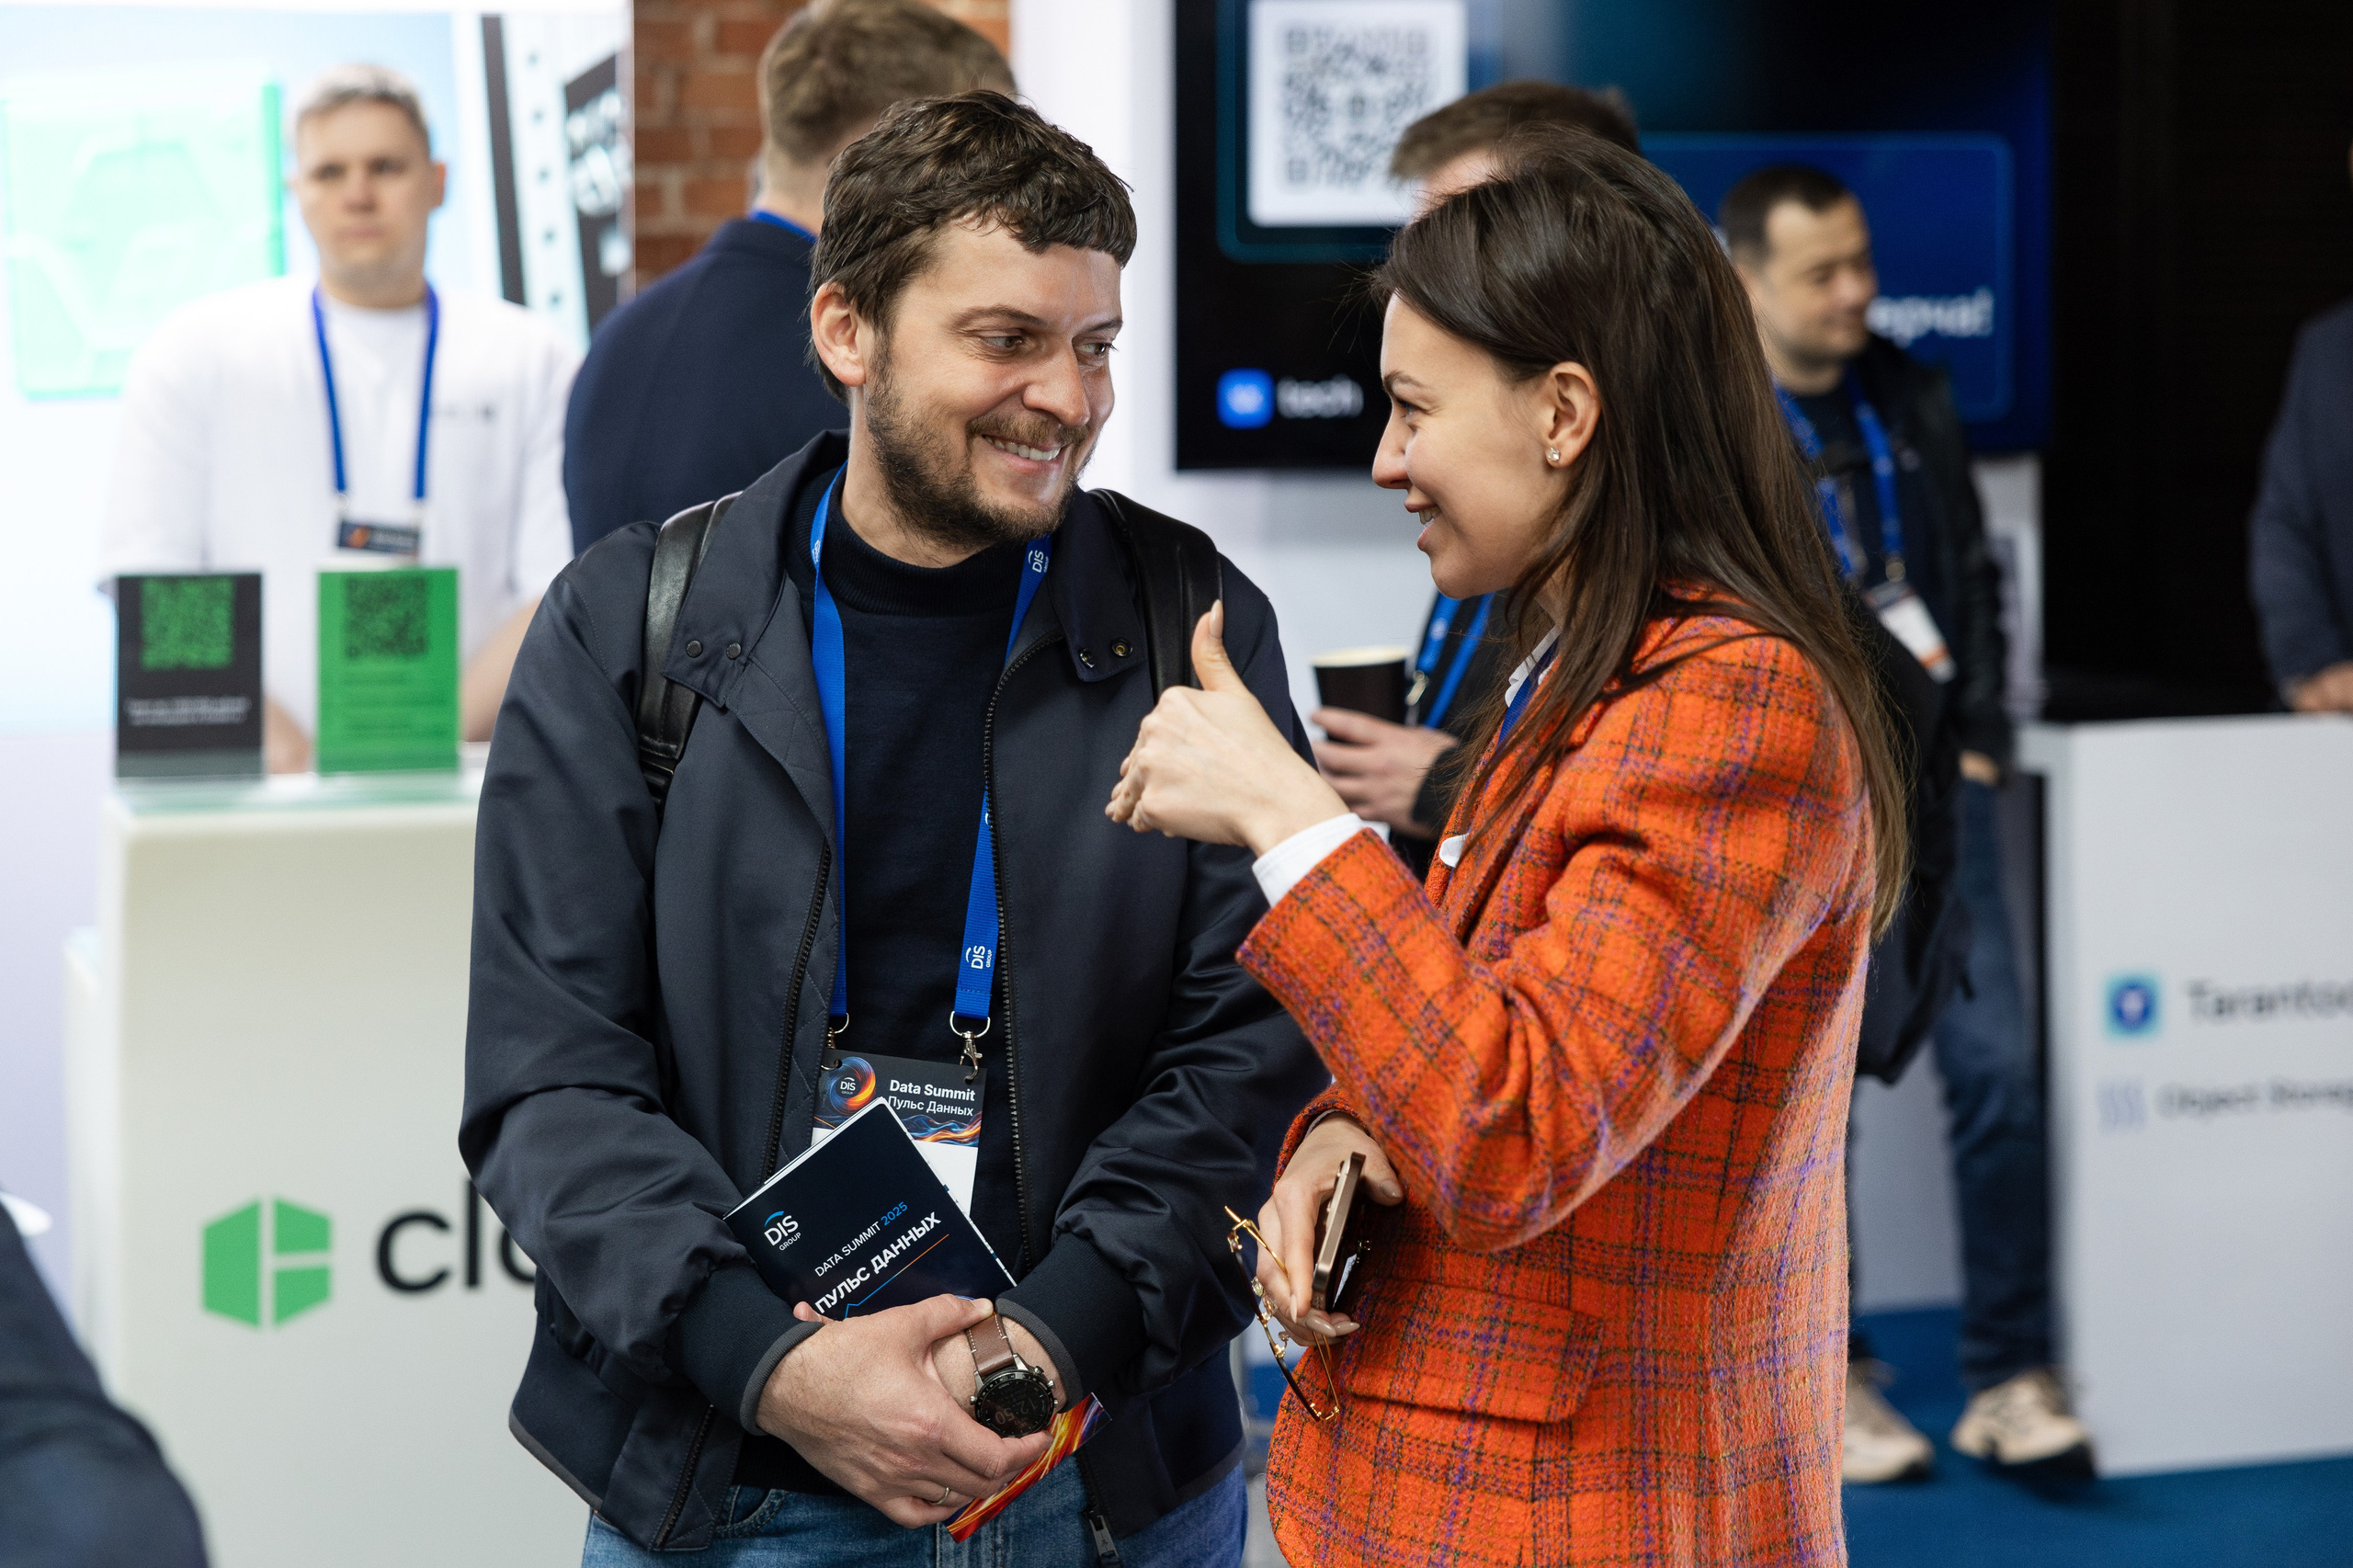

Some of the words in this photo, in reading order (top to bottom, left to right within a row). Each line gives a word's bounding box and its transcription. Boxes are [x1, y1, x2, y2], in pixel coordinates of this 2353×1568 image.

[1278, 375, 1362, 417] tech
[1032, 550, 1044, 574] DIS
[971, 945, 986, 970] DIS
[840, 1081, 856, 1091] DIS
[889, 1079, 921, 1095] Data
[924, 1084, 976, 1102] Summit
[888, 1096, 925, 1110] Пульс
[926, 1101, 974, 1117] Данных
[764, 1215, 799, 1246] DIS
[779, 1232, 801, 1251] GROUP
[814, 1253, 844, 1277] DATA
[841, 1221, 881, 1256] SUMMIT
[881, 1201, 908, 1226] 2025
[814, 1267, 870, 1313] ПУЛЬС
[870, 1211, 941, 1274] ДАННЫХ
